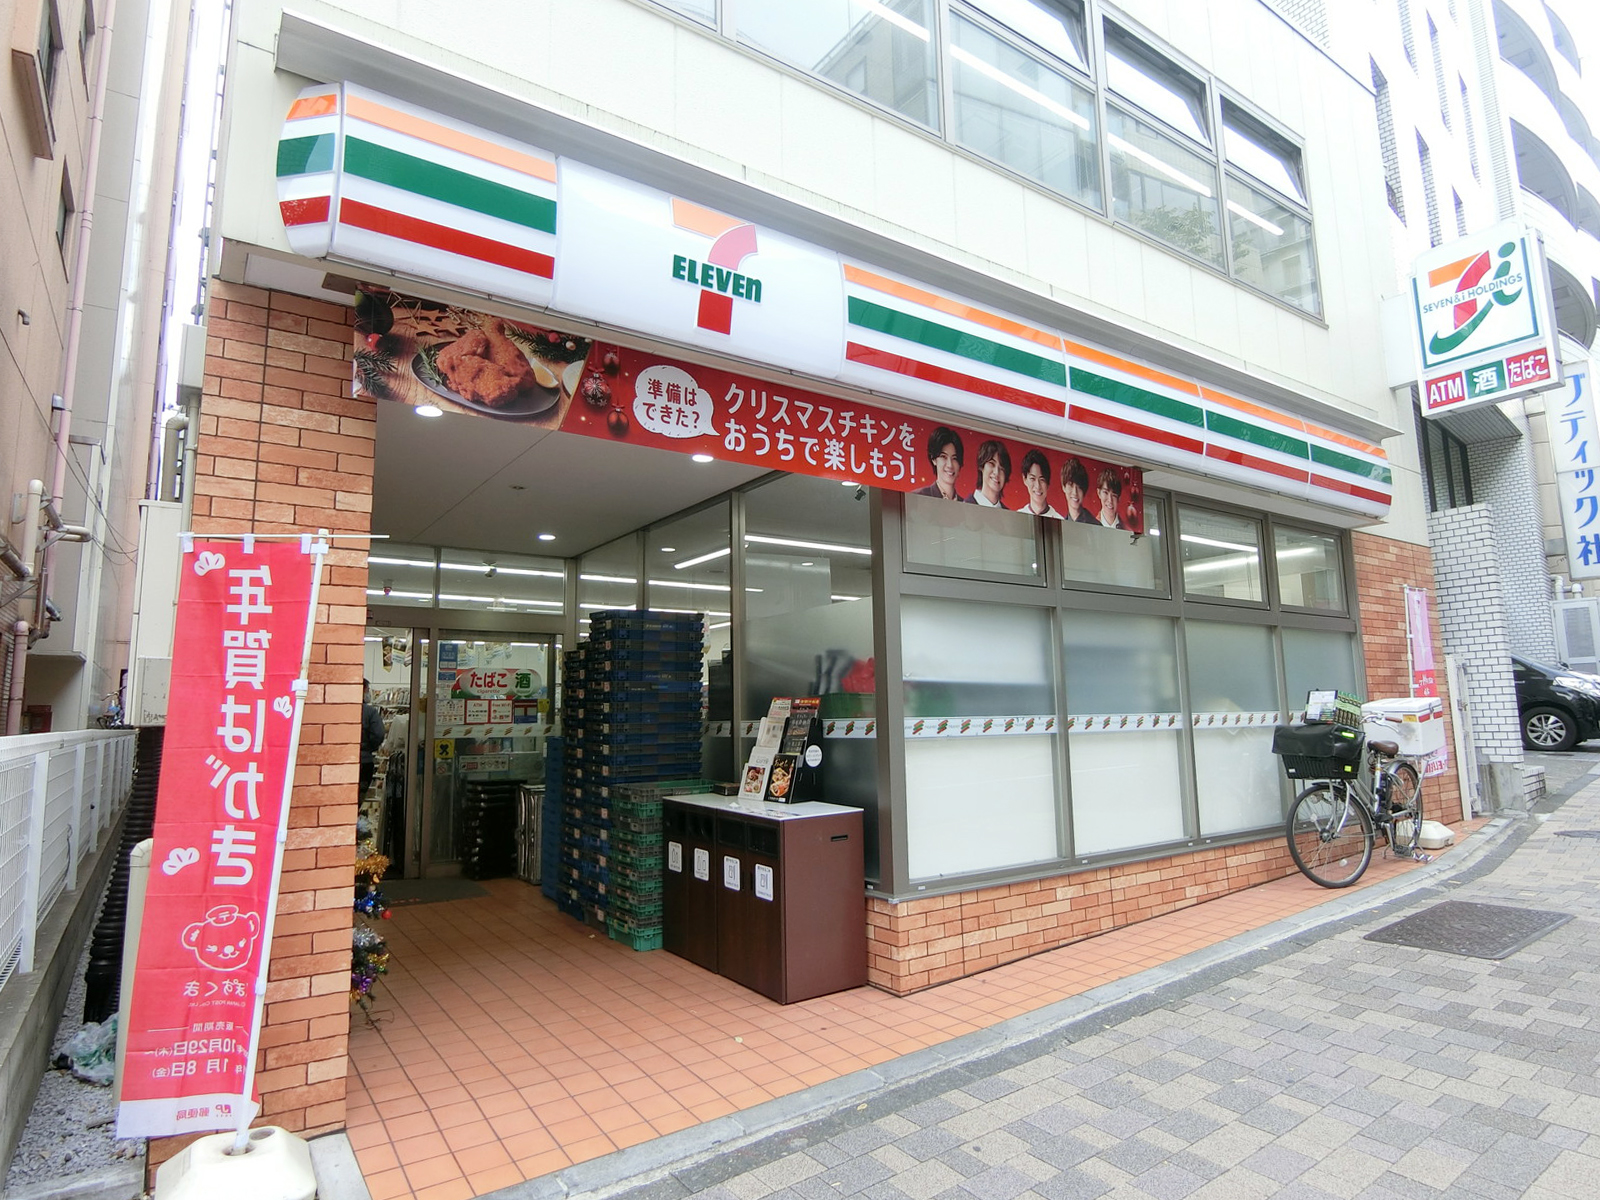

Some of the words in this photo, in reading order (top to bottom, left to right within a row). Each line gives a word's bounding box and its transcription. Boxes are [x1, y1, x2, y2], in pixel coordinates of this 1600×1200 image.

[1467, 273, 1523, 300] HOLDINGS
[647, 378, 698, 407] 準備は
[1429, 378, 1463, 404] ATM
[1473, 367, 1498, 394] 酒
[1508, 353, 1549, 384] たばこ
[724, 383, 916, 452] クリスマスチキンを
[724, 418, 916, 484] おうちで楽しもう!
[470, 671, 508, 688] たばこ
[515, 672, 532, 689] 酒
